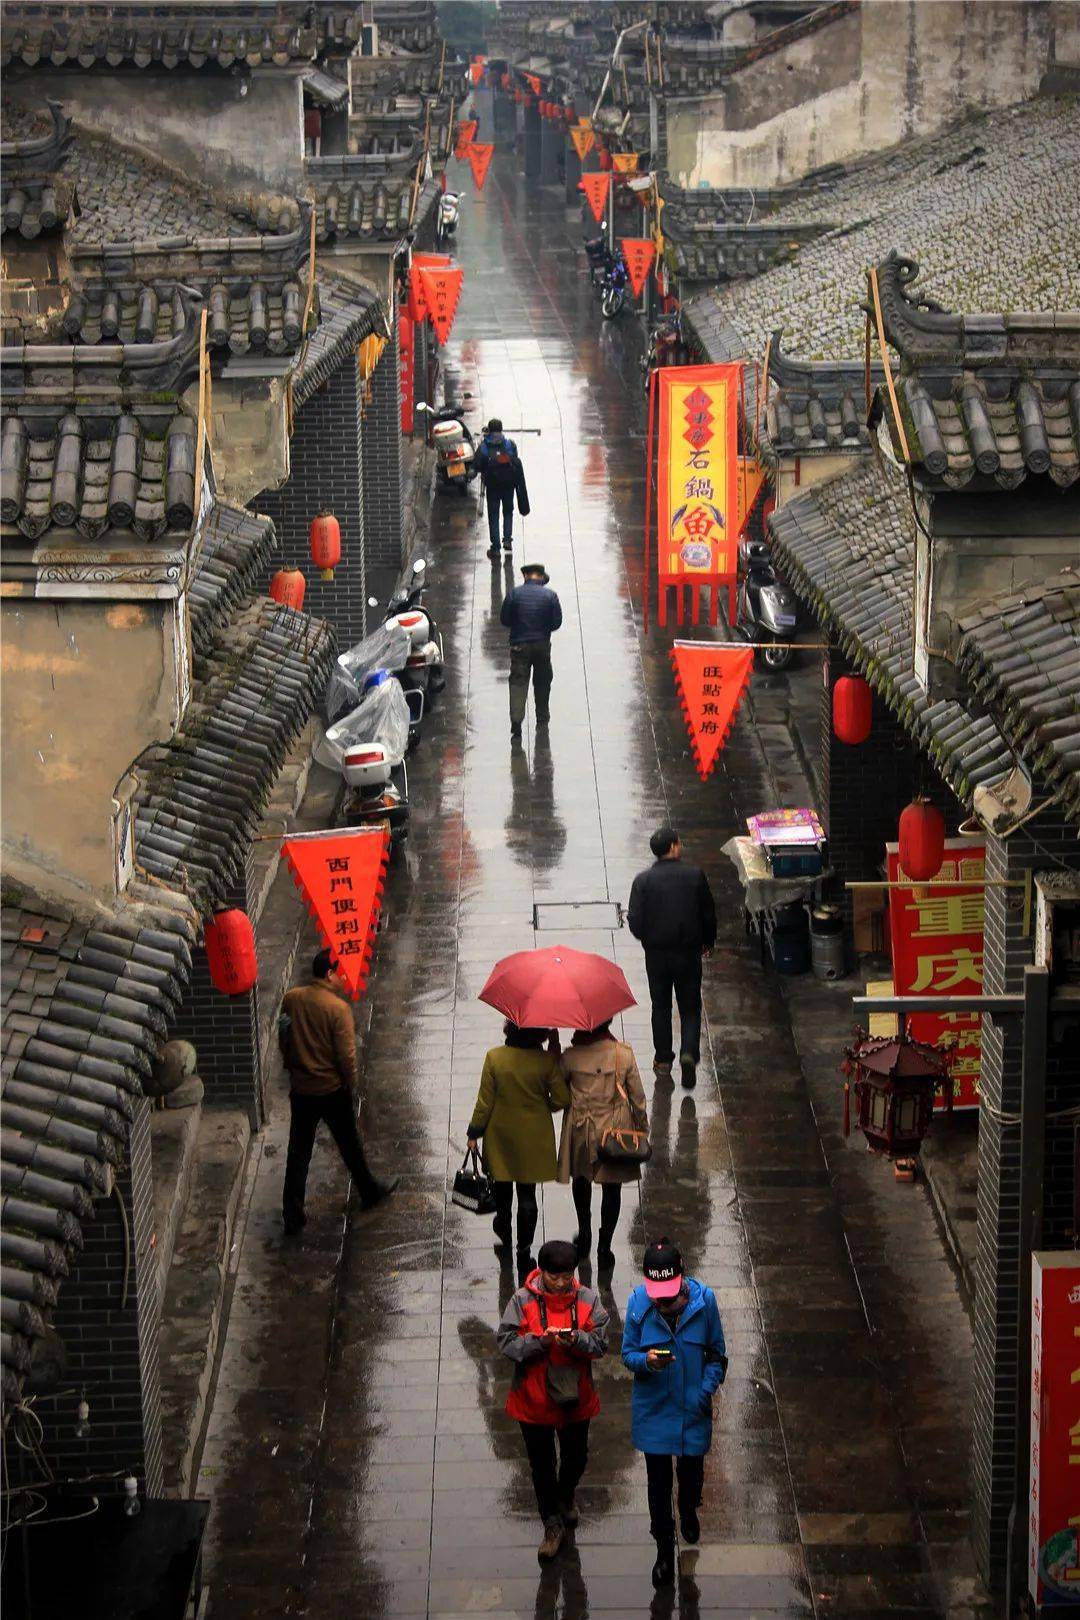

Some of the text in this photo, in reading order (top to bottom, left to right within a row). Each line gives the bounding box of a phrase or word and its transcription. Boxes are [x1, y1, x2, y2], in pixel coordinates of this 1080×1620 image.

[326, 856, 362, 956] 西門便利店
